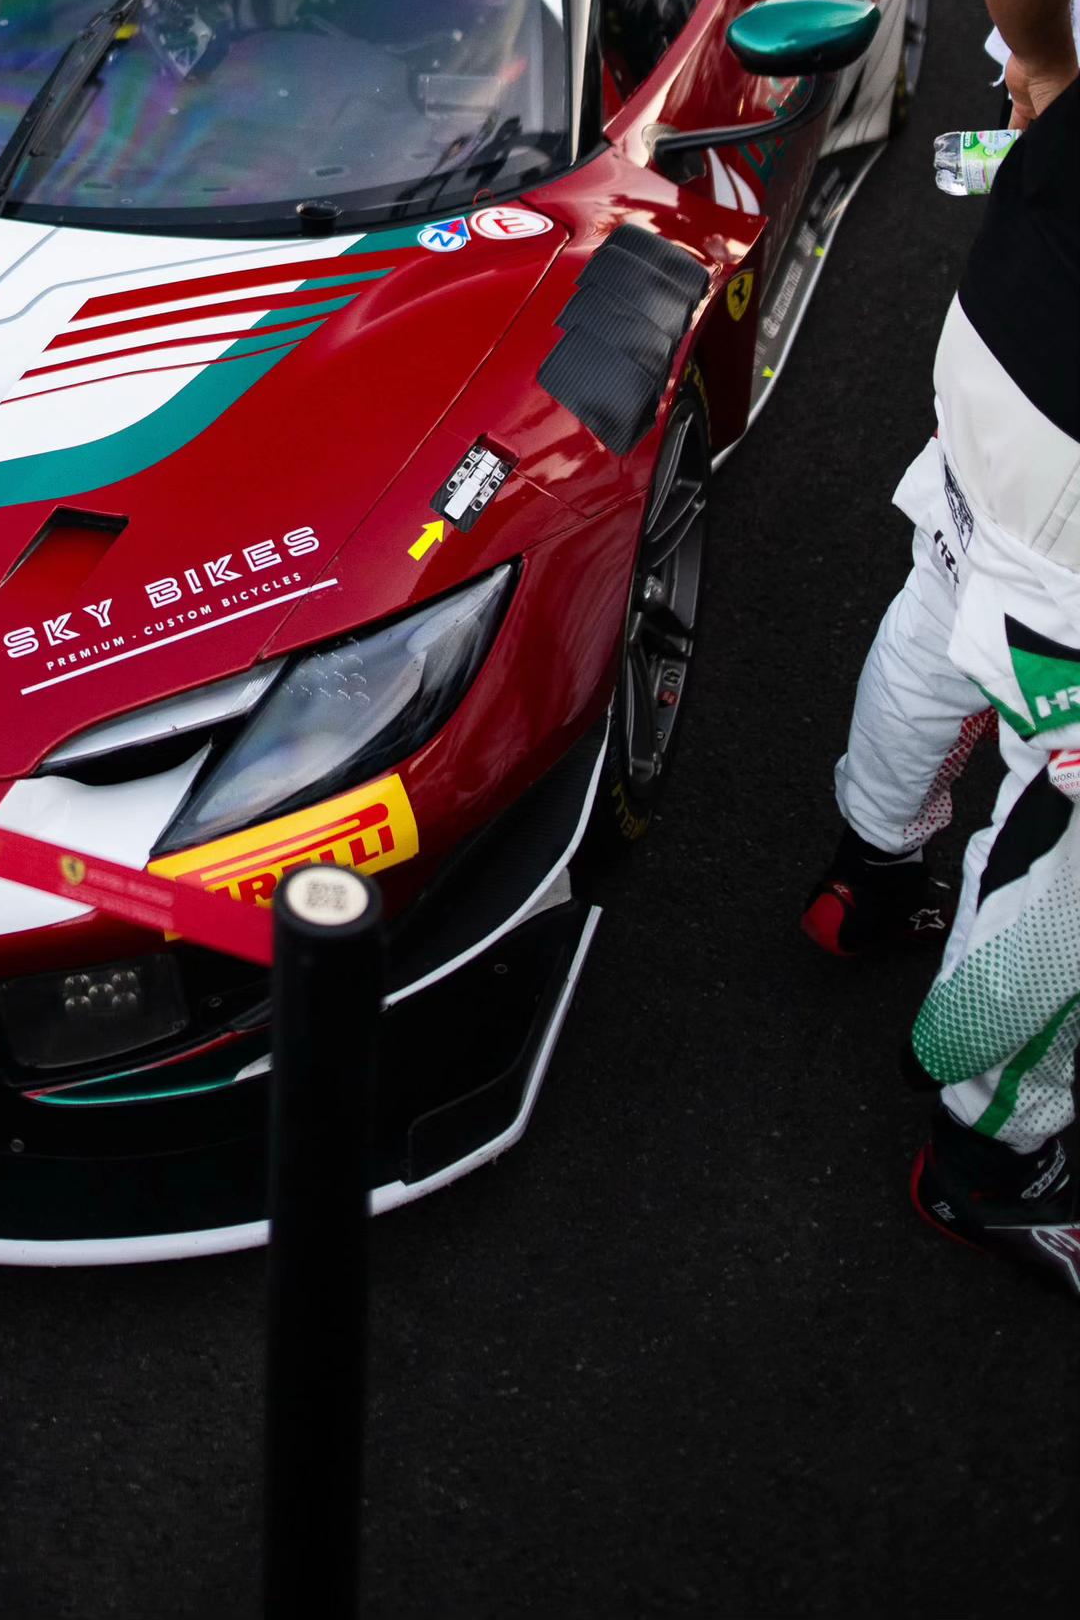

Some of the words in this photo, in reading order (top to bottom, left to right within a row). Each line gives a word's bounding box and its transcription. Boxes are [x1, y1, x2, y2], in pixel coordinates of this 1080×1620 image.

[2, 598, 114, 659] SKY
[143, 525, 320, 610] BIKES
[45, 634, 126, 671] PREMIUM
[143, 603, 213, 636] CUSTOM
[220, 571, 303, 609] BICYCLES
